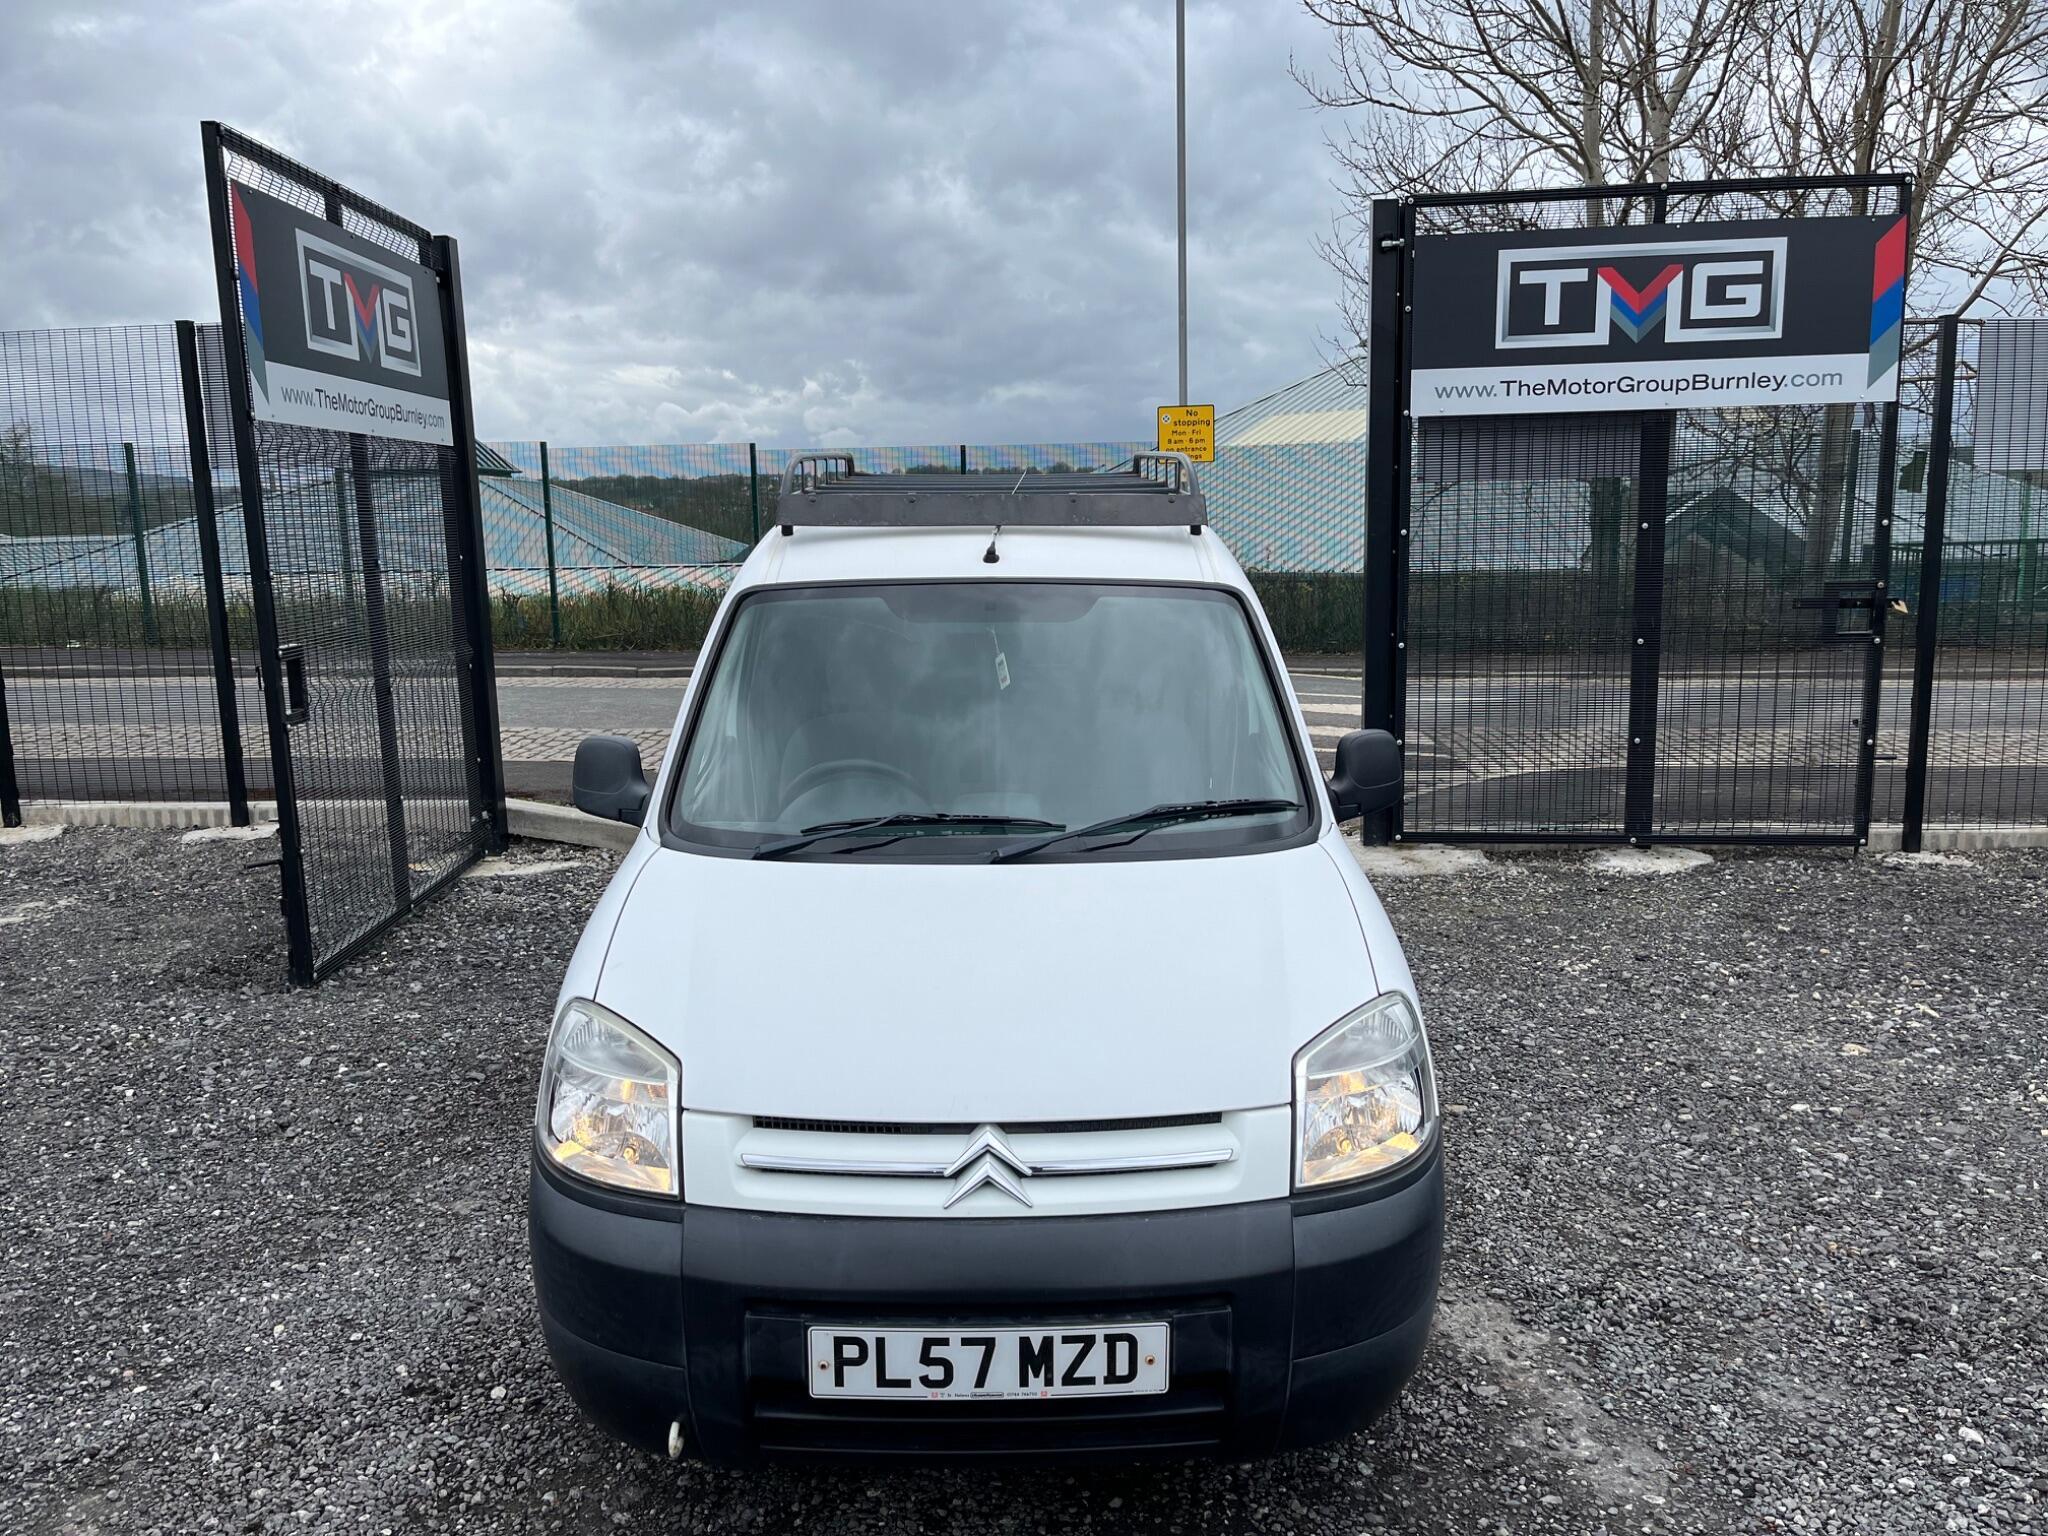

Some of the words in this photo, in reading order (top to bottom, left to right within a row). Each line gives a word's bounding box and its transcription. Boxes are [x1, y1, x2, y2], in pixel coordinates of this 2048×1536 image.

[305, 256, 416, 366] TMG
[1516, 258, 1768, 345] TMG
[1434, 370, 1844, 400] www.TheMotorGroupBurnley.com
[281, 386, 445, 429] www.TheMotorGroupBurnley.com
[1173, 419, 1211, 427] stopping
[1186, 409, 1198, 417] No
[832, 1335, 997, 1389] PL57
[1018, 1333, 1139, 1388] MZD
